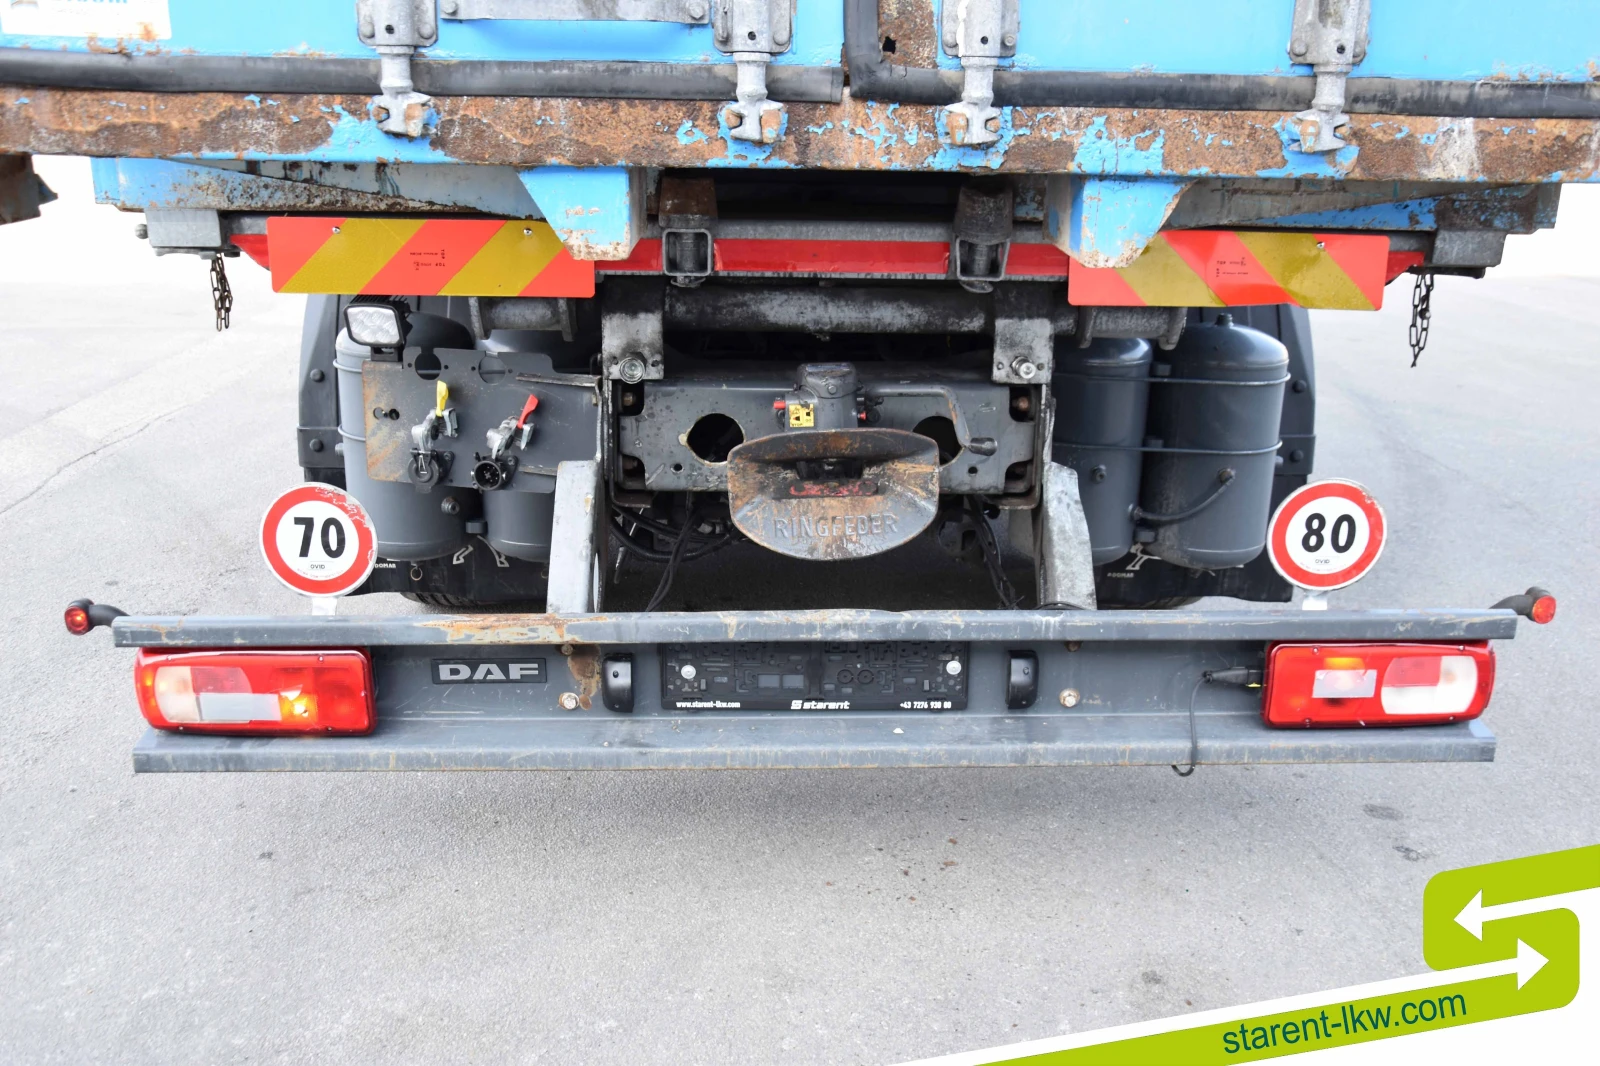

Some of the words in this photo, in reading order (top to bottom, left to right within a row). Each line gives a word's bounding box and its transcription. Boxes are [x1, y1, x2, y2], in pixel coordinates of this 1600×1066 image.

[774, 513, 898, 538] RINGFEDER
[1302, 513, 1356, 553] 80
[294, 517, 345, 558] 70
[439, 663, 538, 680] DAF
[676, 700, 740, 708] www.starent-lkw.com
[803, 700, 850, 709] starent
